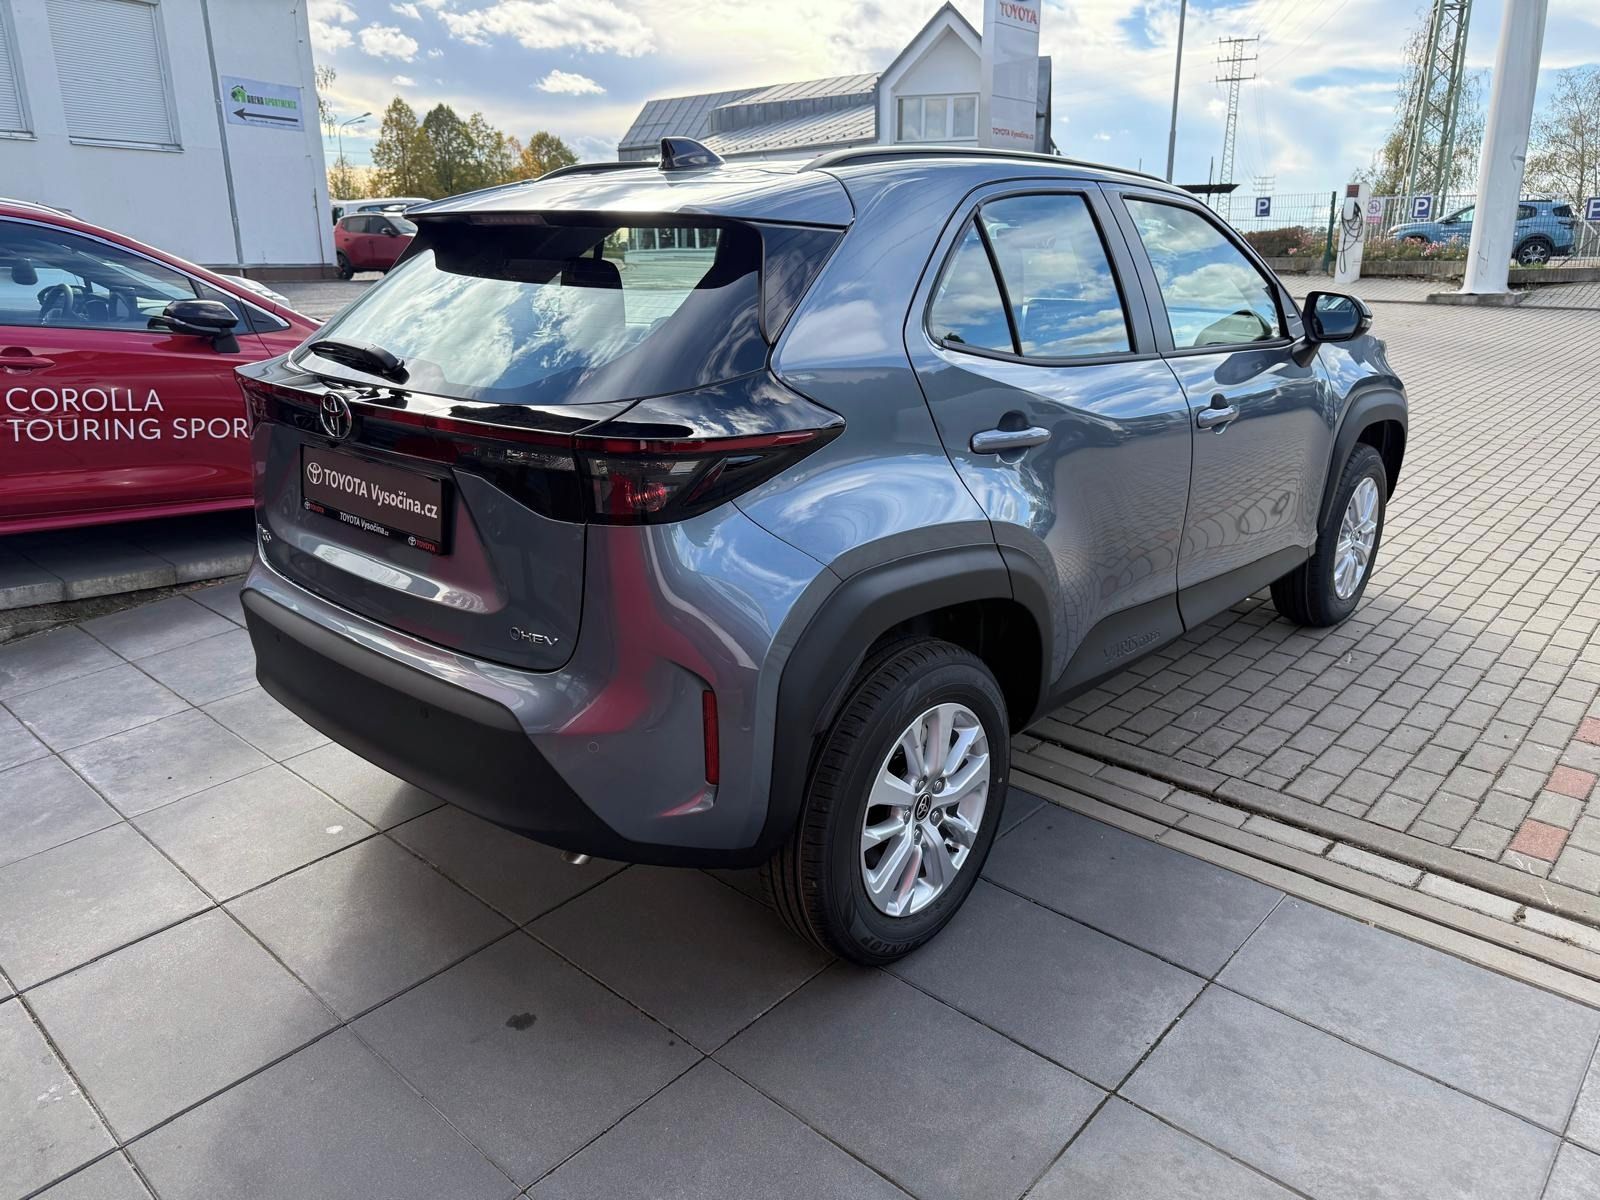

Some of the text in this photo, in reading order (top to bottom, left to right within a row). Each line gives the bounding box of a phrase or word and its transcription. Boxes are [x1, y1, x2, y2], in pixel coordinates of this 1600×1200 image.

[1000, 2, 1037, 25] TOYOTA
[1256, 198, 1269, 216] P
[1413, 198, 1429, 217] P
[6, 387, 164, 412] COROLLA
[6, 417, 161, 442] TOURING
[323, 468, 438, 519] TOYOTA Vysočina.cz
[339, 511, 361, 528] TOYOTA
[416, 539, 436, 553] TOYOTA
[521, 631, 558, 646] HEV
